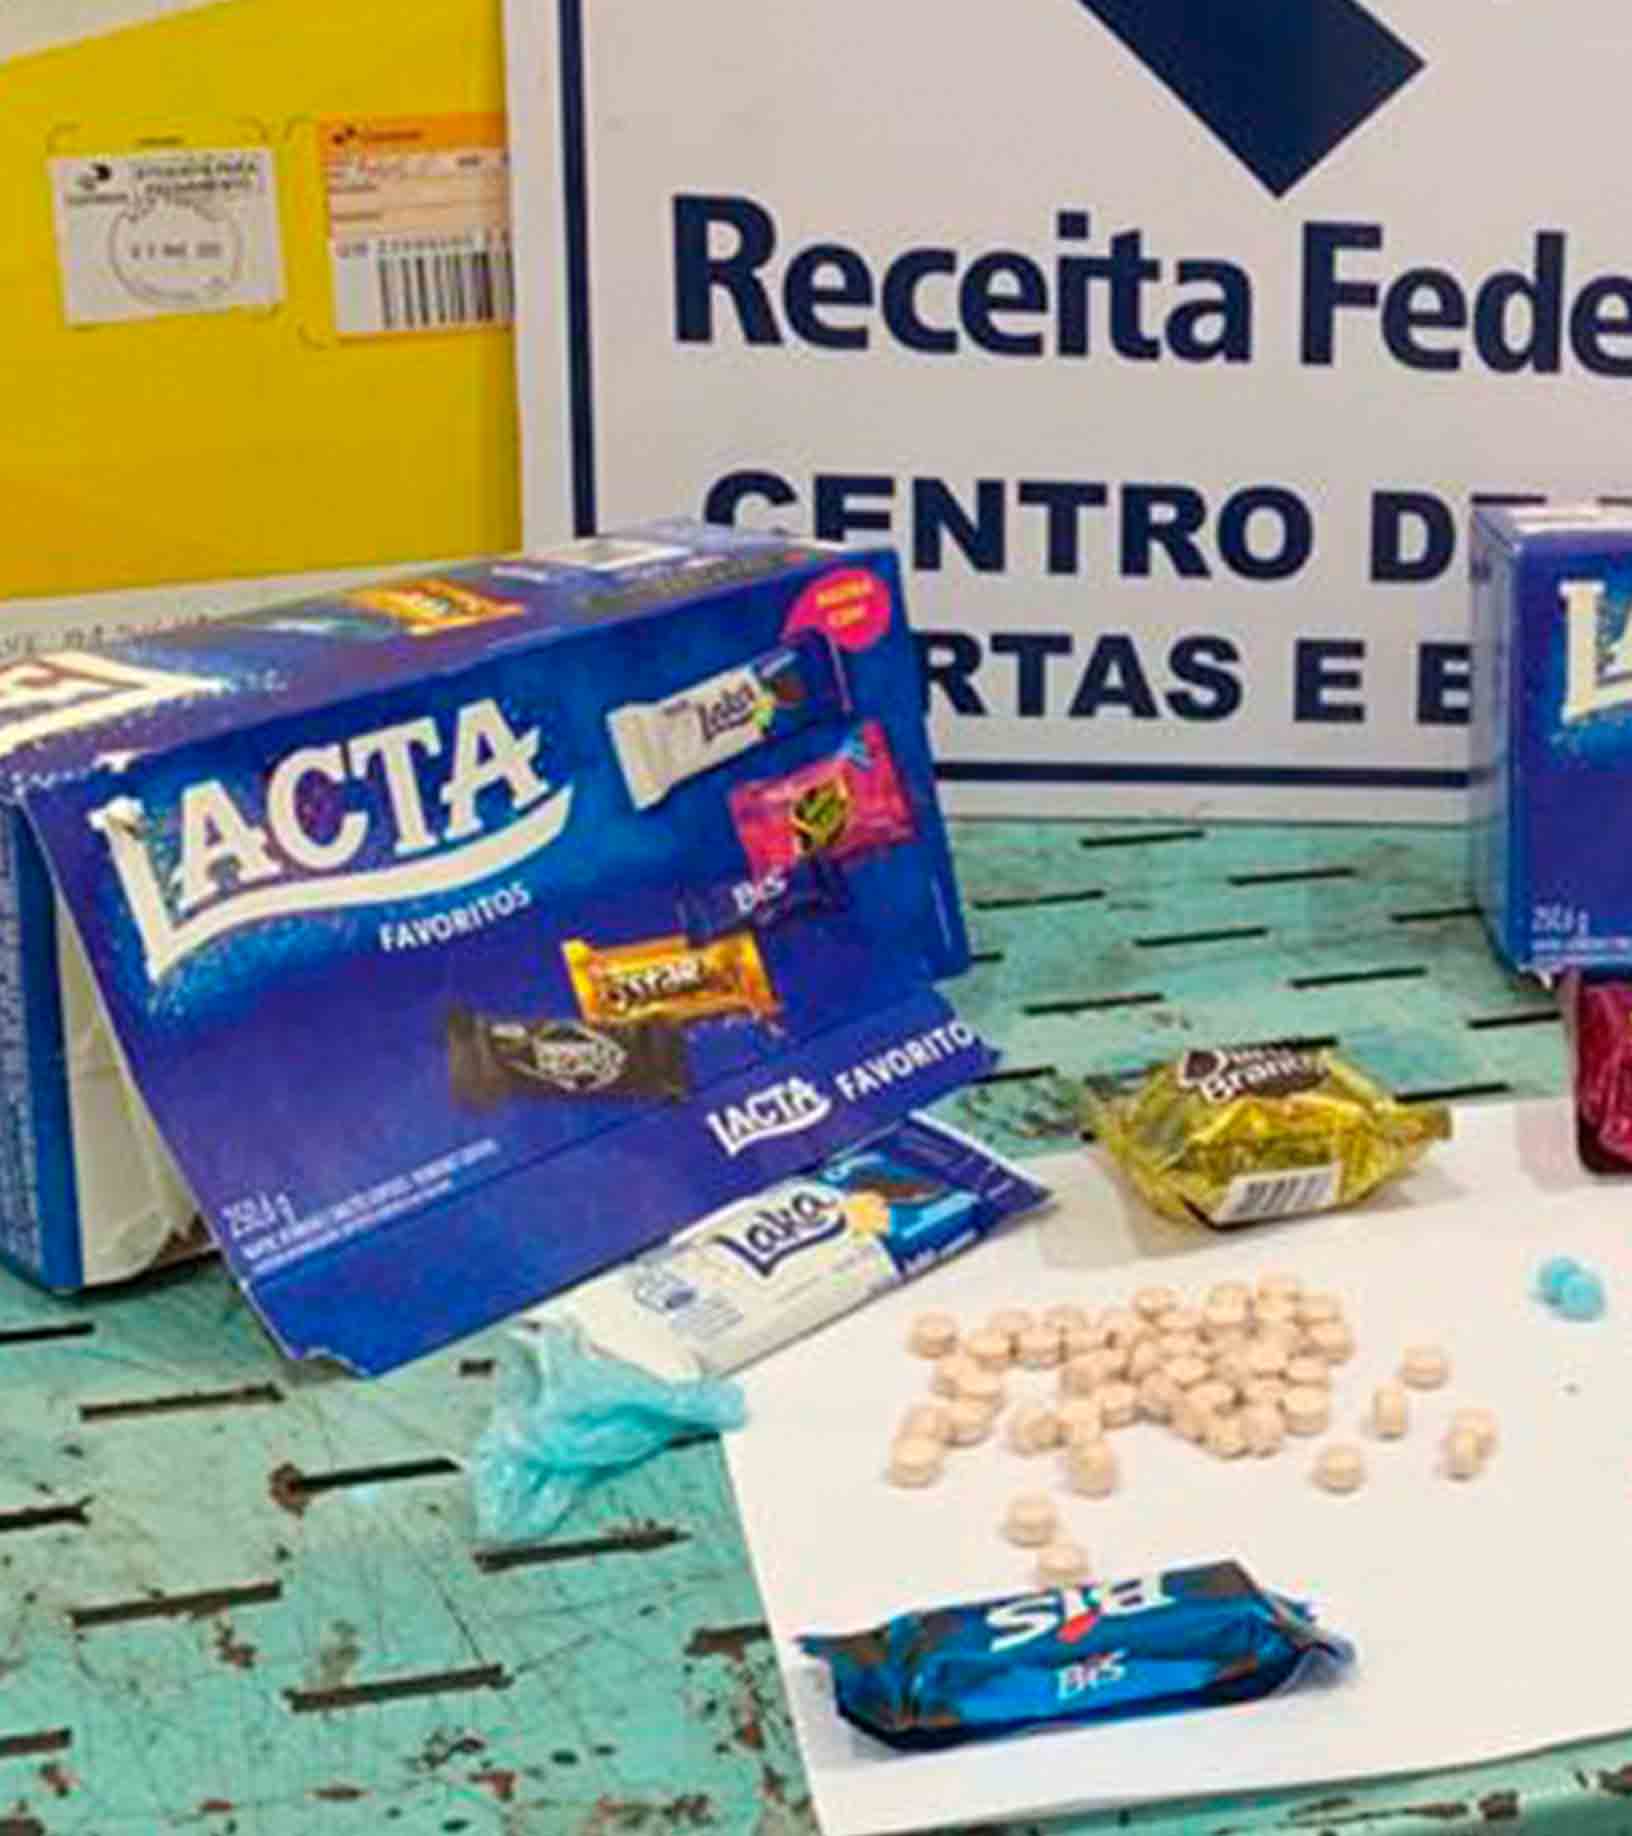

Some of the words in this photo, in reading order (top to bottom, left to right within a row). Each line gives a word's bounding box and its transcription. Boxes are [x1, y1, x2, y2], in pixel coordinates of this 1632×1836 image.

[671, 194, 1253, 363] Receita
[703, 469, 1314, 581] CENTRO
[1369, 490, 1547, 584] D
[911, 631, 1244, 721] RTAS
[1293, 639, 1366, 724] E
[87, 698, 574, 983] LACTA
[378, 882, 532, 951] FAVORITOS
[706, 1076, 833, 1158] LACTA
[834, 1019, 977, 1102] FAVORITO
[713, 1188, 850, 1278] Laka
